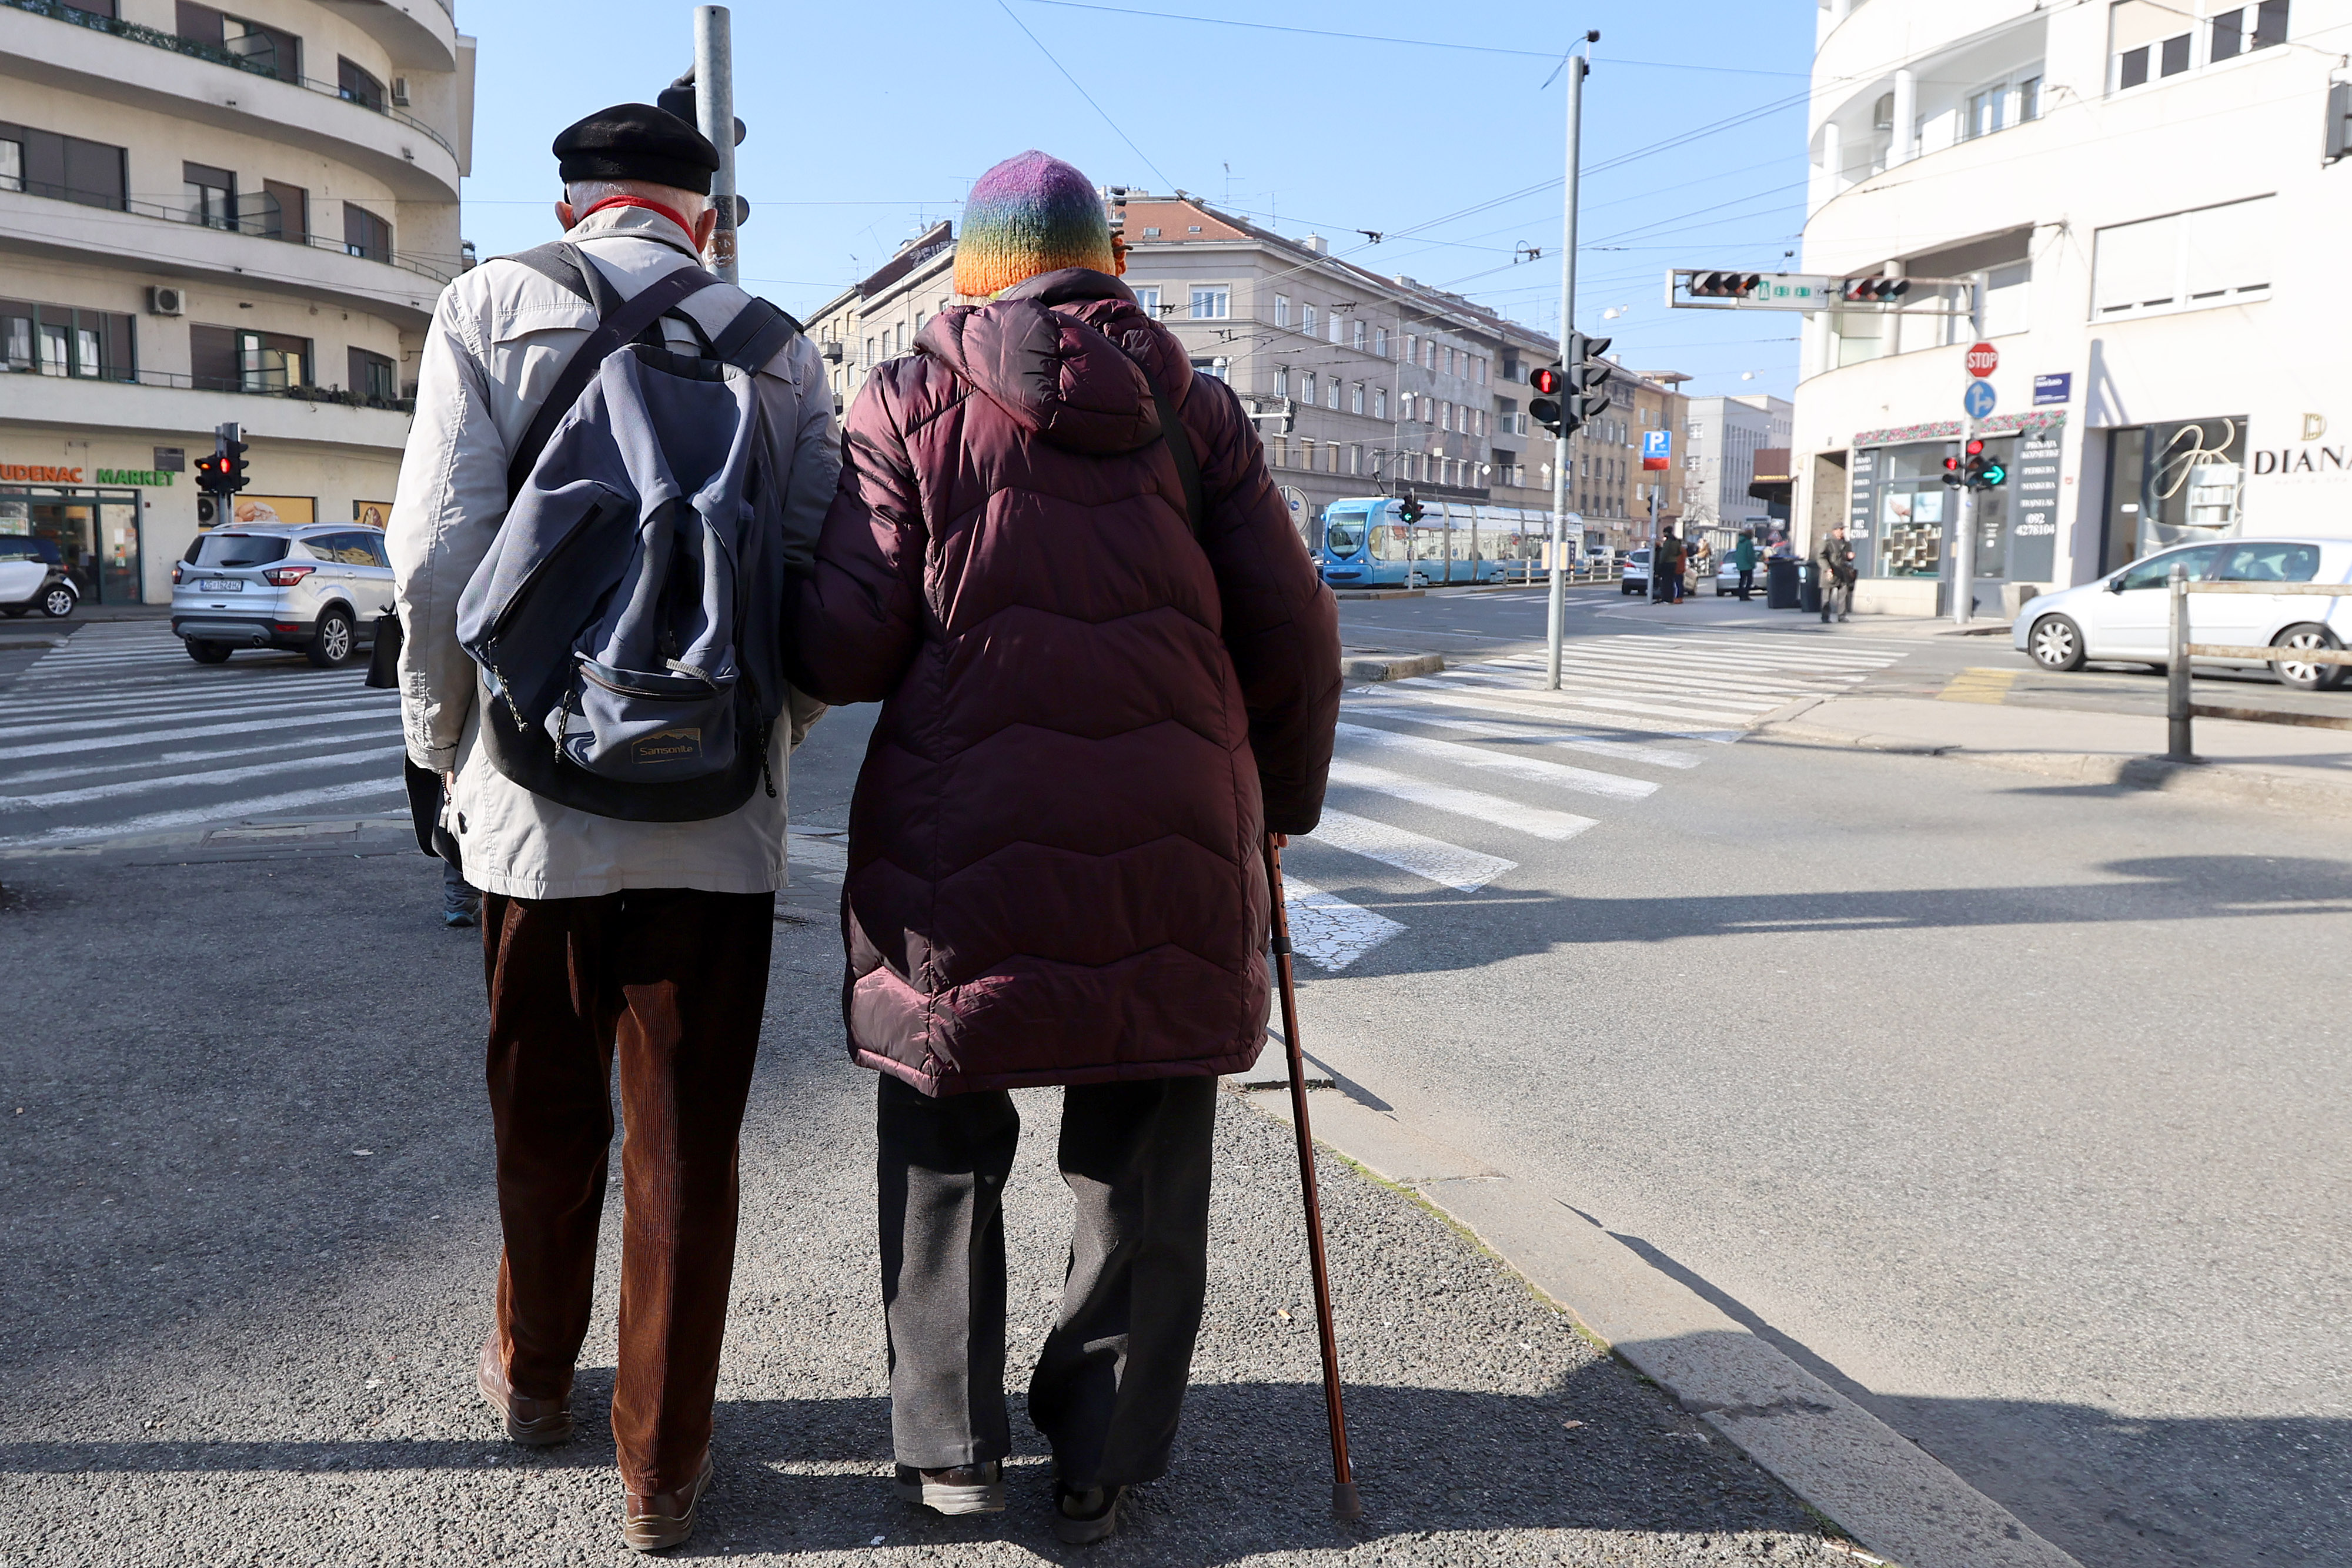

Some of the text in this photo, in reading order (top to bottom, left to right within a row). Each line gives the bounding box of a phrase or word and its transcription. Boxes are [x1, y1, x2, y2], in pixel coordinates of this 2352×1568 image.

[1968, 352, 1997, 369] STOP
[1650, 432, 1665, 451] P
[97, 469, 175, 486] MARKET
[2026, 513, 2045, 524] 092
[2015, 524, 2055, 536] 4278104
[640, 745, 693, 756] Samsonite
